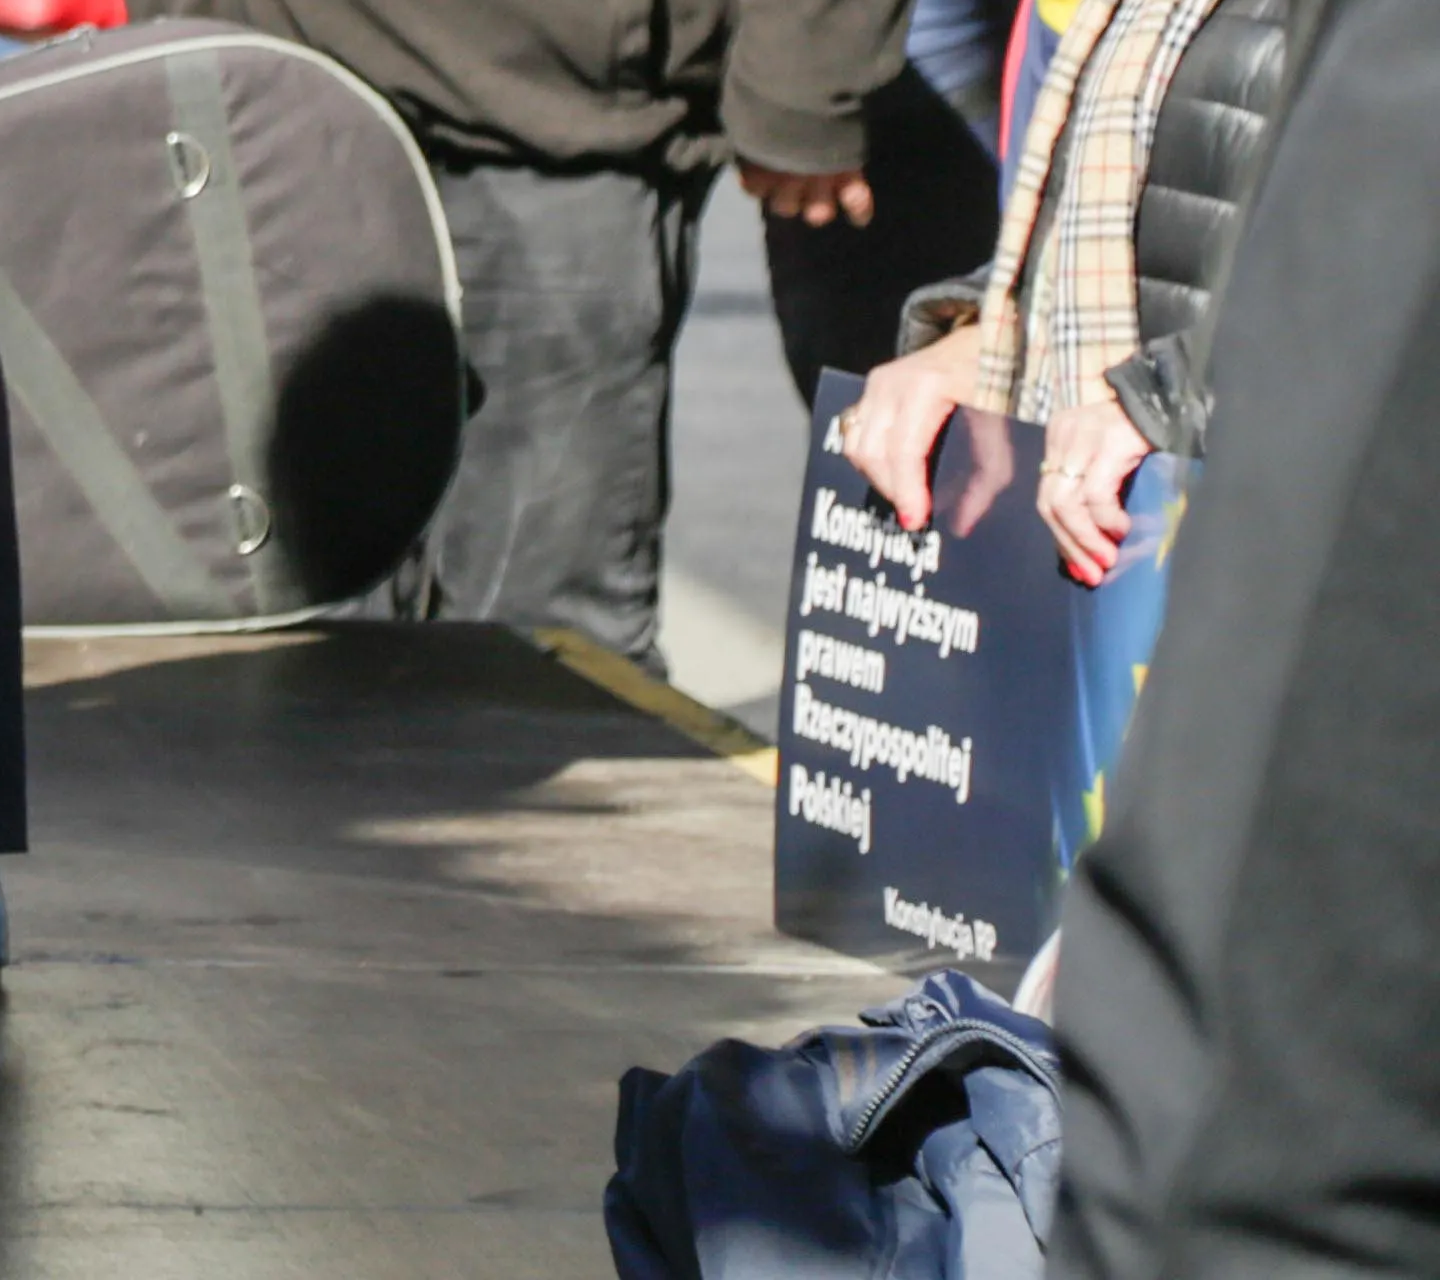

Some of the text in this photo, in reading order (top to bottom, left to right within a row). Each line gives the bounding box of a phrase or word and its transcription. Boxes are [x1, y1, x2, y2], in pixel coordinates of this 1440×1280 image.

[799, 551, 979, 659] jest najwyższym
[796, 628, 886, 694] prawem
[792, 682, 973, 805] Rzeczypospolitej
[788, 763, 872, 856] Polskiej
[883, 886, 998, 962] Konstytucja RP
